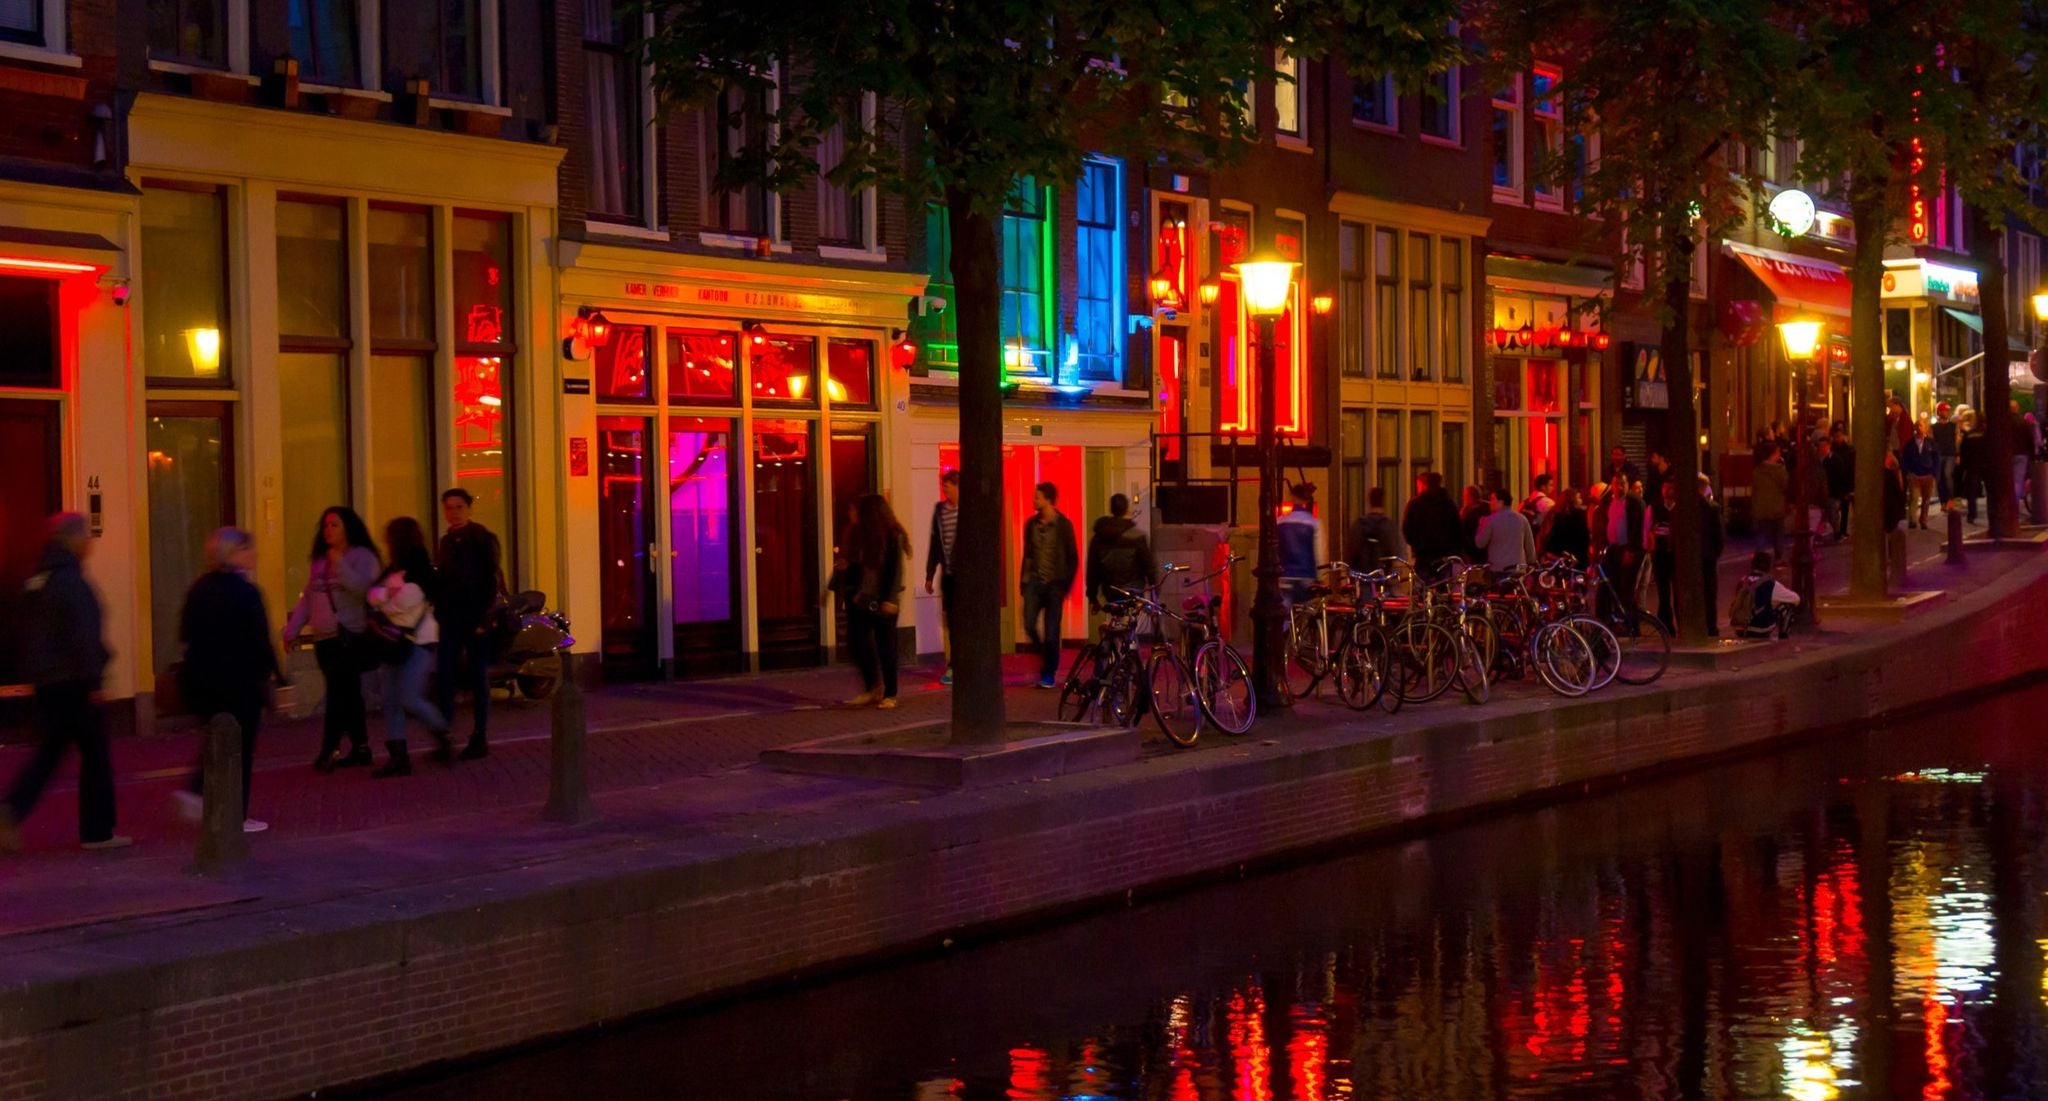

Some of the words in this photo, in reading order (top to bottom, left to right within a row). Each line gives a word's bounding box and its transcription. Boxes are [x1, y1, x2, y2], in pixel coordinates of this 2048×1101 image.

[626, 283, 647, 296] KAMER
[896, 400, 906, 412] 40
[87, 475, 99, 489] 44
